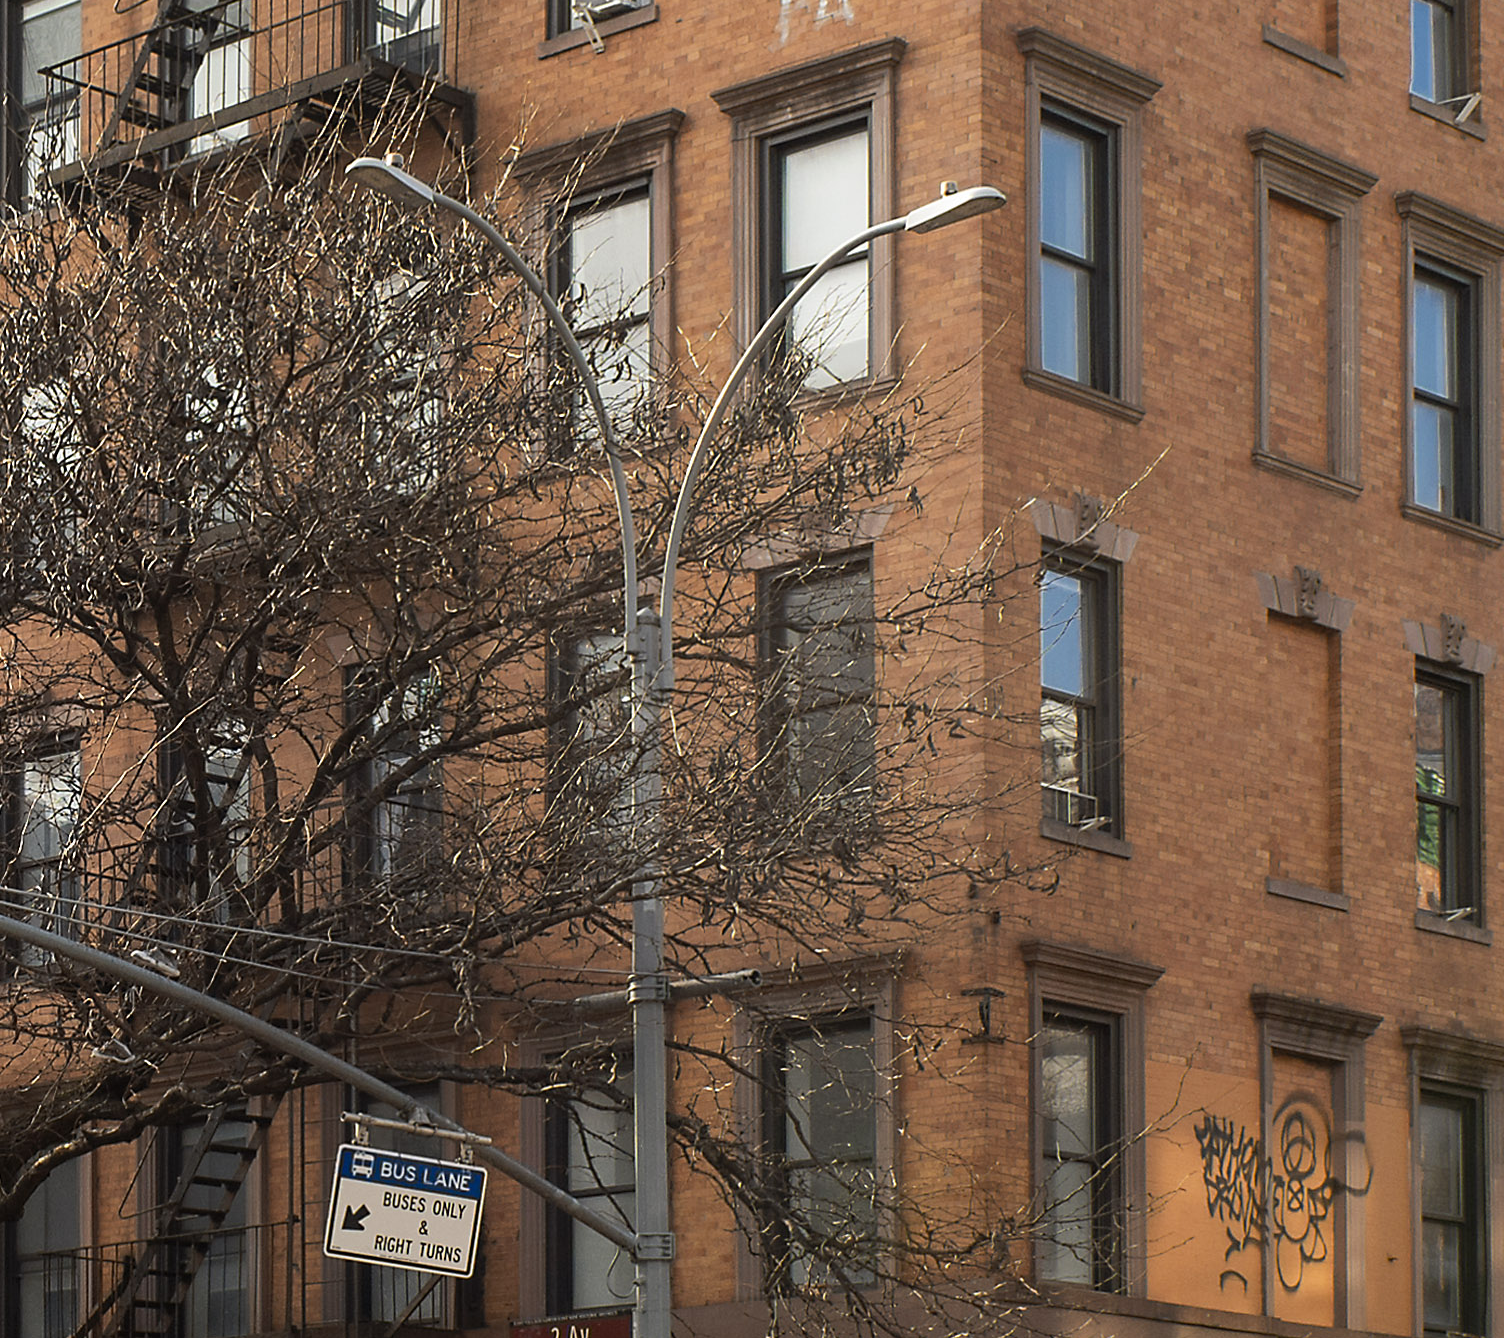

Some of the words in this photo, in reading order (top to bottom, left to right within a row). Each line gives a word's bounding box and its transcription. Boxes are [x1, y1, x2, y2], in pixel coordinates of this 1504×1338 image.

[381, 1161, 417, 1182] BUS
[423, 1168, 472, 1192] LANE
[383, 1191, 427, 1213] BUSES
[432, 1200, 467, 1220] ONLY
[418, 1220, 429, 1236] &
[374, 1235, 413, 1255] RIGHT
[420, 1242, 462, 1263] TURNS
